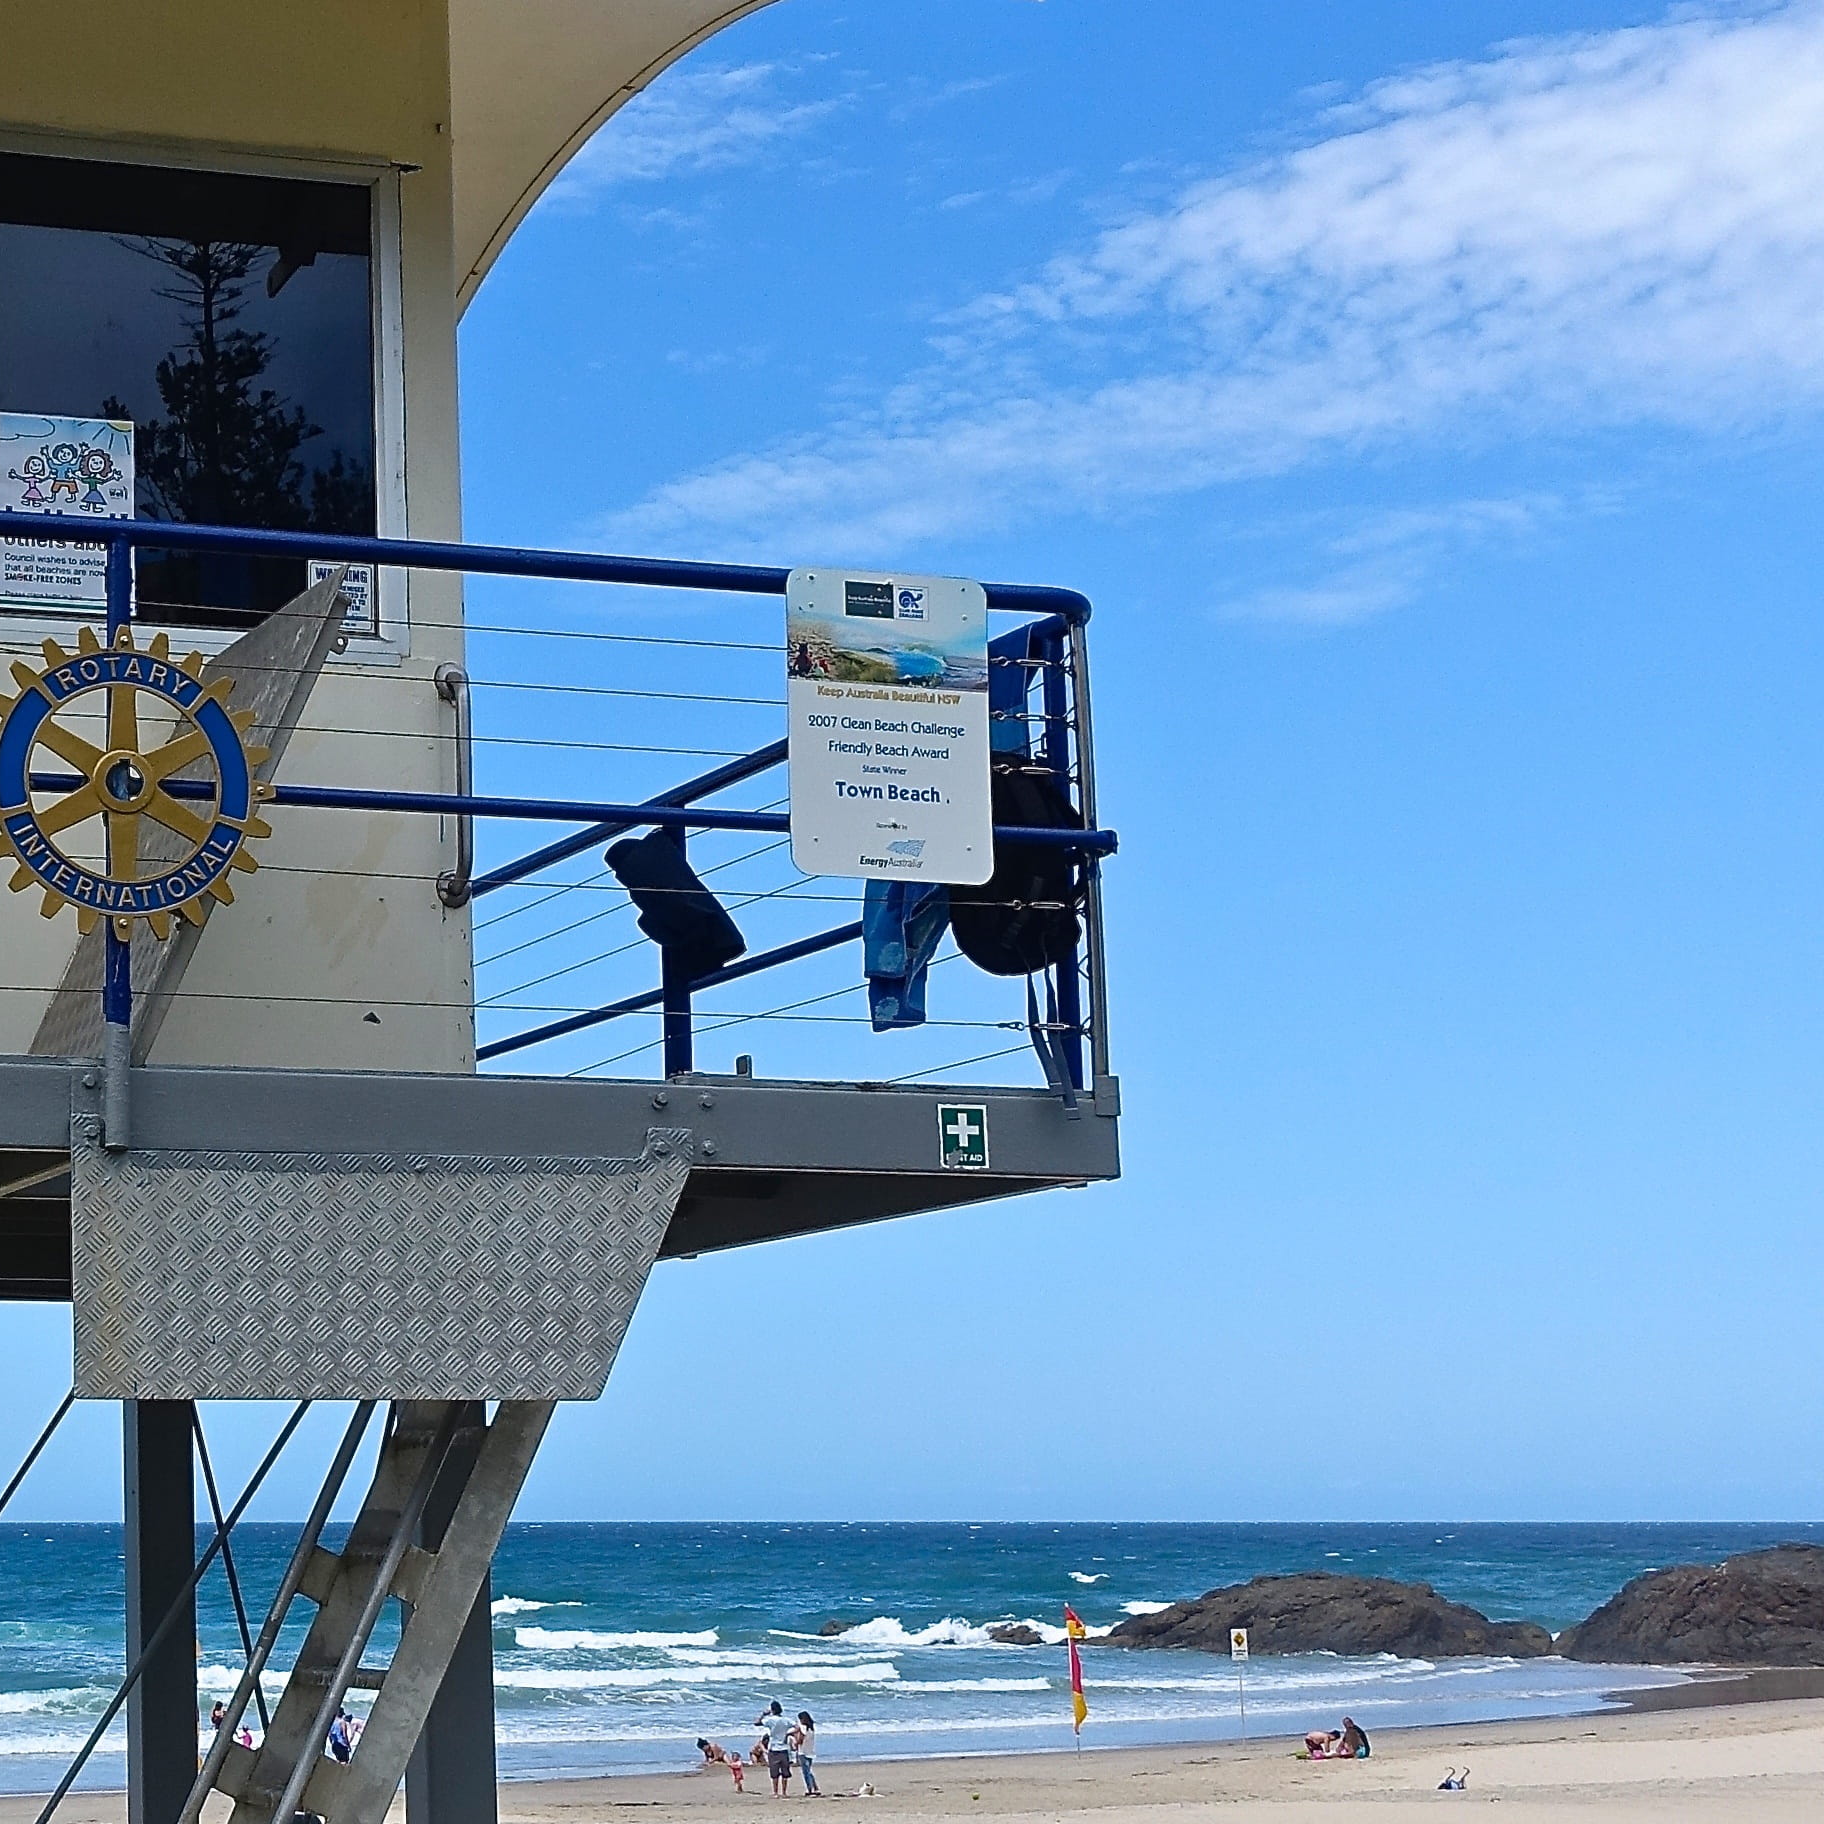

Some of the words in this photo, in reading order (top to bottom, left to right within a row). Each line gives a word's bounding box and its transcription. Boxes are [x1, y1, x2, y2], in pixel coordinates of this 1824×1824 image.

[4, 553, 35, 562] Council
[38, 556, 67, 565] wishes
[79, 557, 106, 567] advise
[4, 564, 21, 572] that
[24, 564, 34, 573] all
[36, 565, 73, 575] beaches
[4, 573, 54, 584] SMOKE-FREE
[56, 576, 82, 586] ZONES
[54, 656, 192, 694] ROTARY
[817, 685, 843, 699] Keep
[846, 687, 889, 701] Australia
[892, 690, 935, 704] Beautiful
[938, 694, 961, 705] NSW
[808, 714, 838, 727] 2007
[841, 716, 871, 730] Clean
[875, 719, 908, 733] Beach
[911, 721, 965, 738] Challenge
[828, 740, 872, 757] Friendly
[876, 743, 909, 757] Beach
[911, 746, 949, 759] Award
[862, 764, 881, 774] State
[882, 765, 907, 775] Winner
[835, 781, 883, 800] Town
[887, 784, 941, 803] Beach
[13, 823, 234, 908] INTERNATIONAL
[969, 1153, 983, 1162] AID
